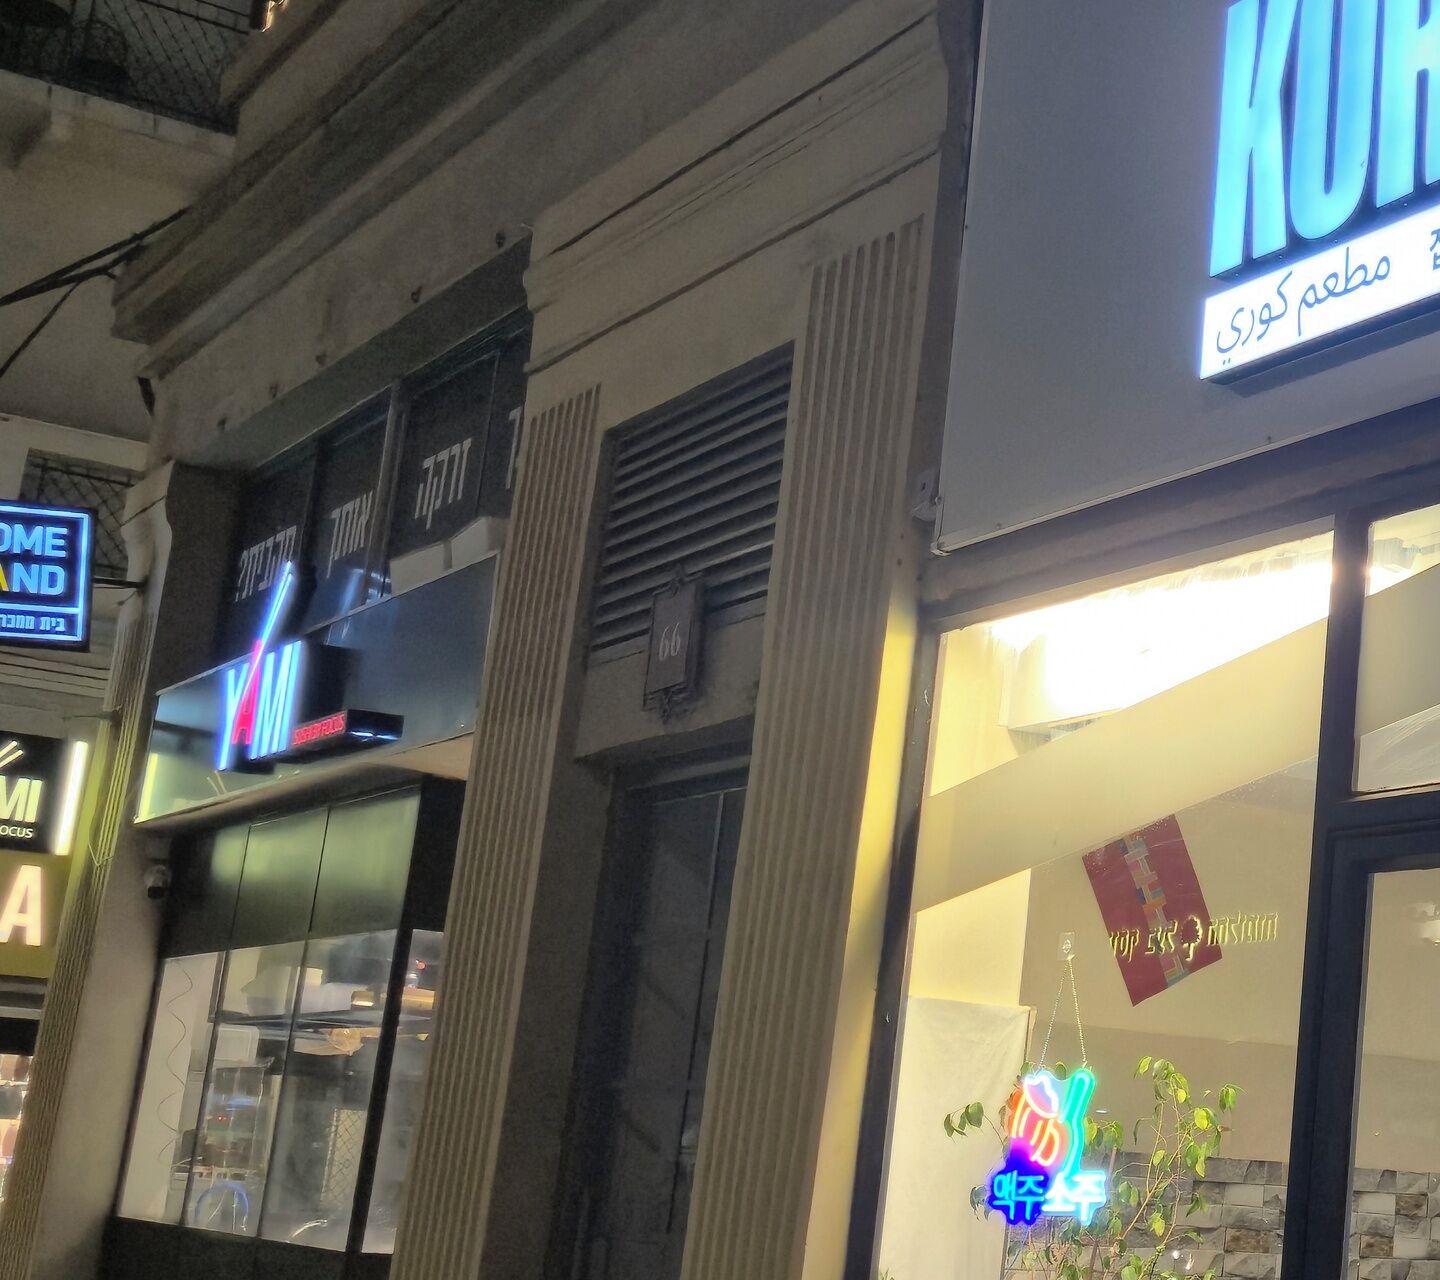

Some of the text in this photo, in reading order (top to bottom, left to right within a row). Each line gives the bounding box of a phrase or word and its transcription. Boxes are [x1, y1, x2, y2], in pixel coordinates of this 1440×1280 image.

[1216, 246, 1391, 365] مطعم كوري
[40, 616, 65, 632] בית
[659, 621, 681, 661] 66
[218, 638, 302, 772] YAMI
